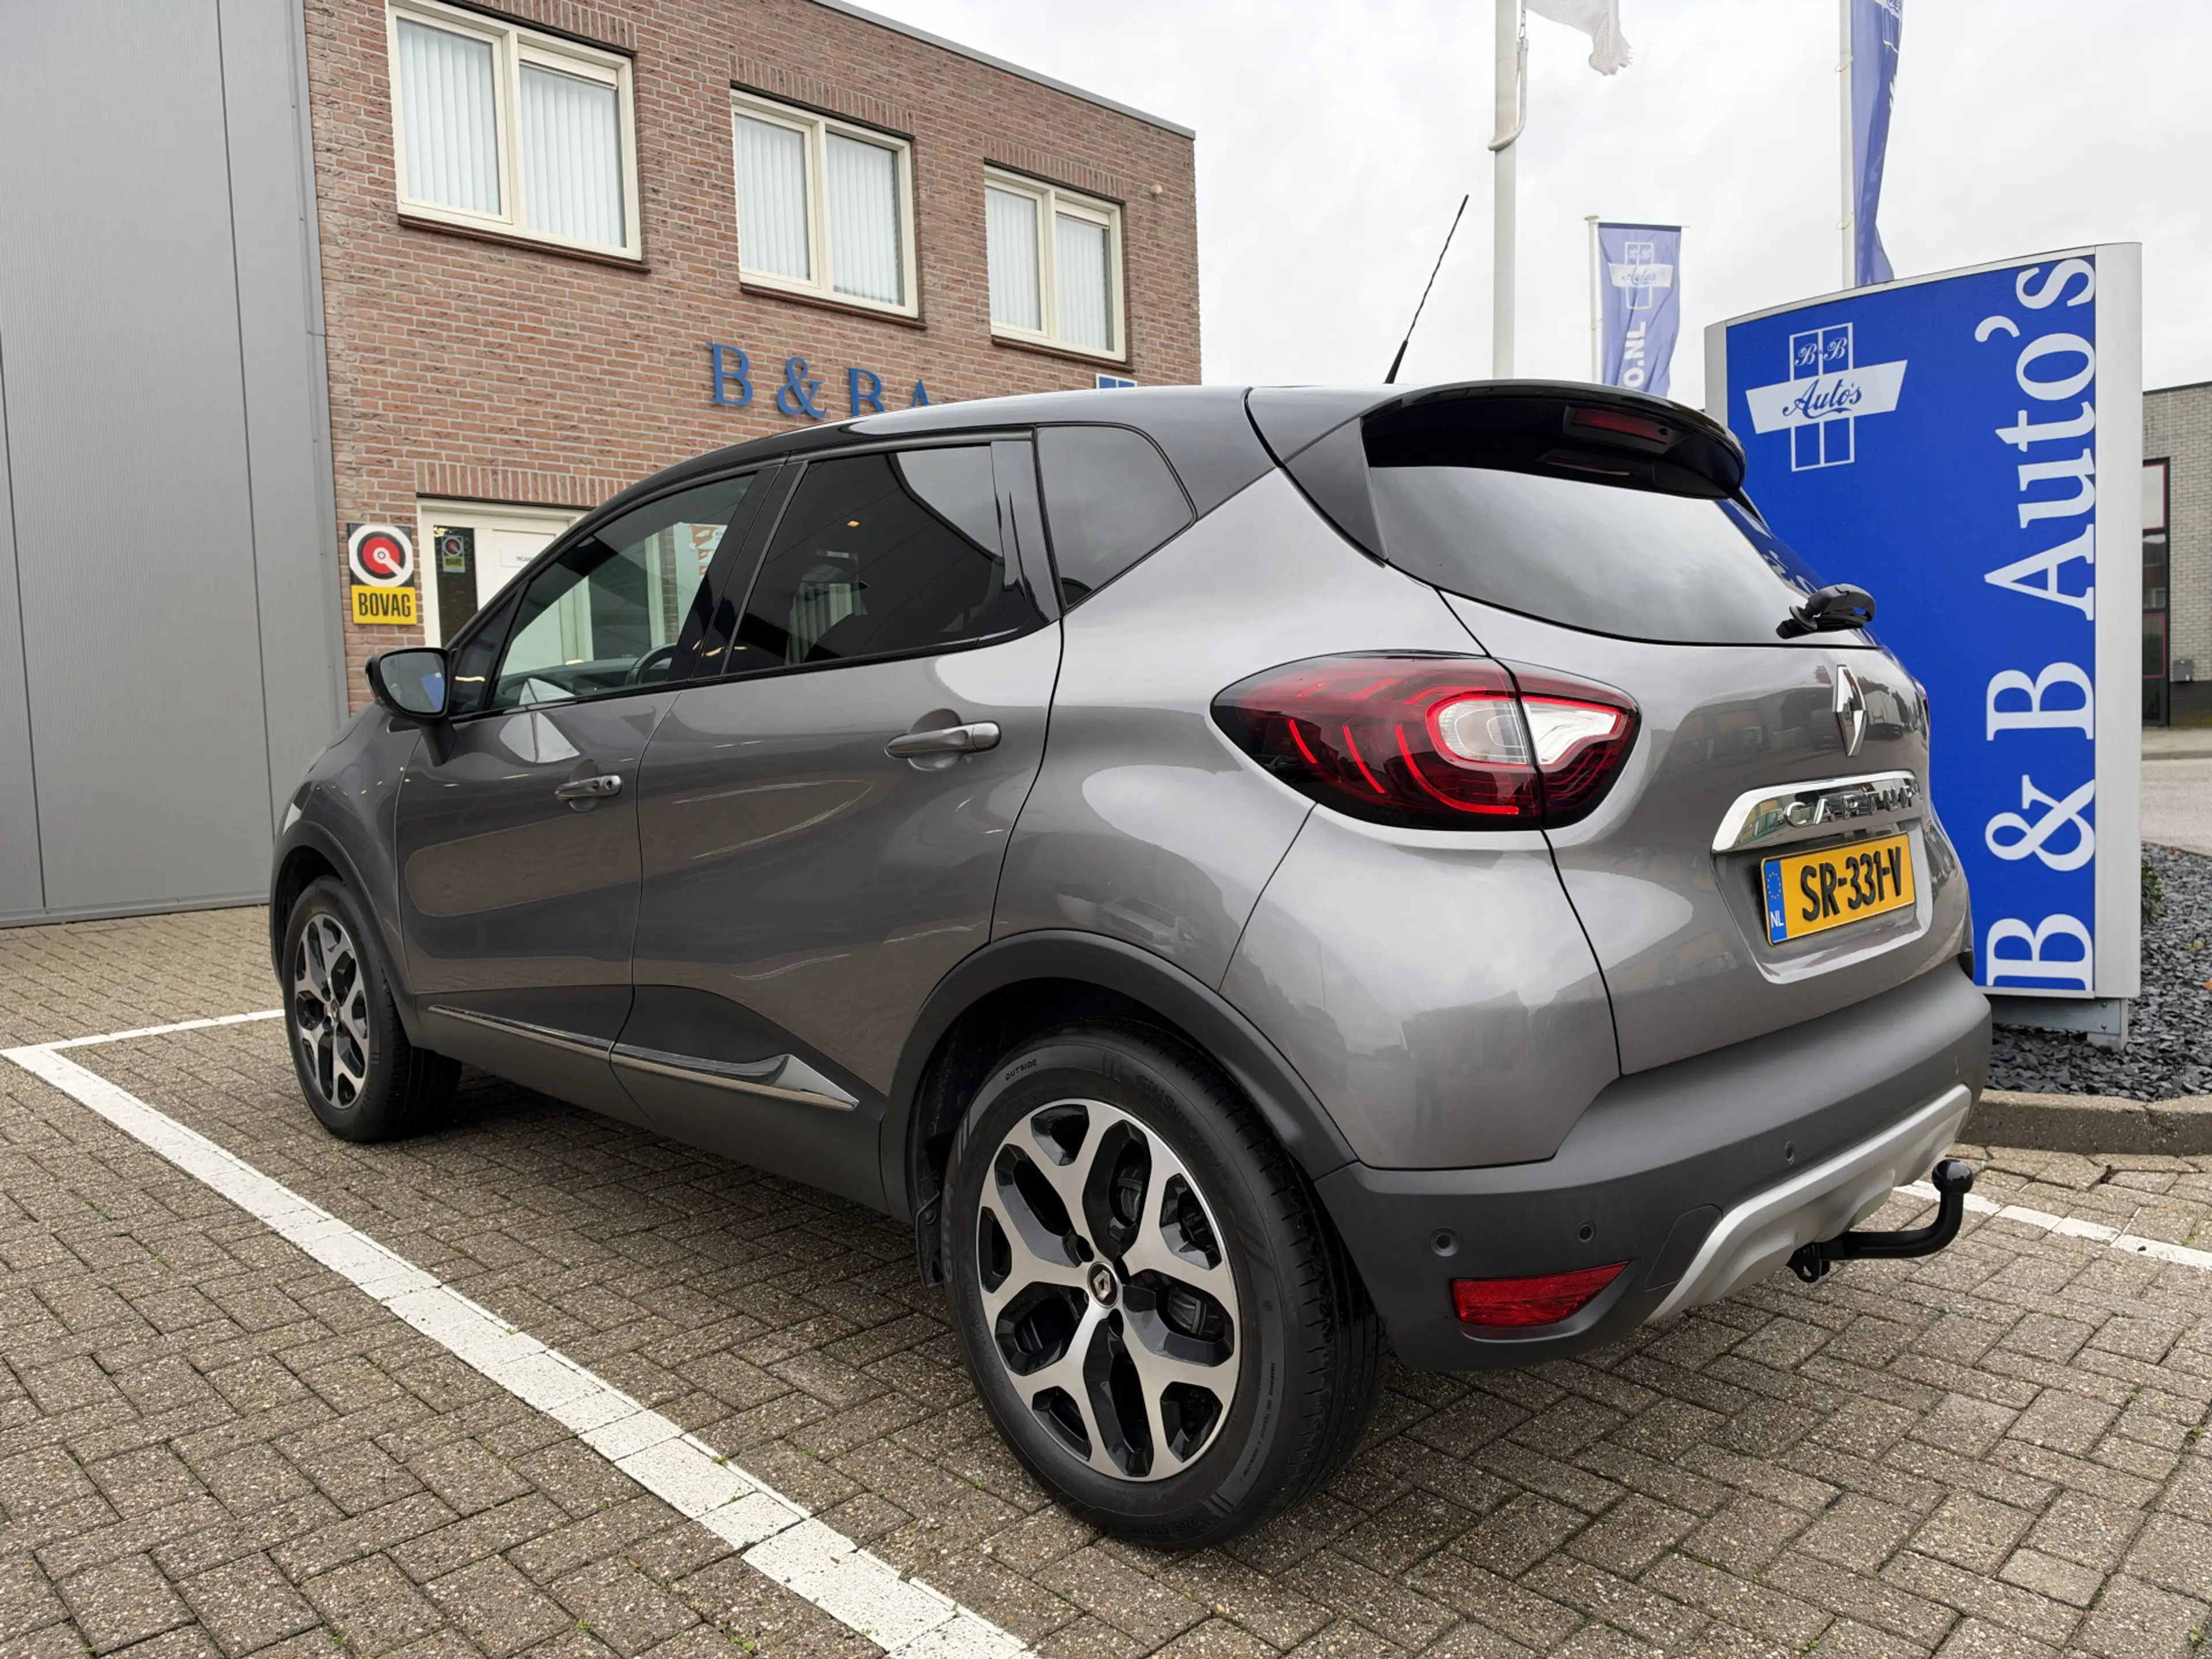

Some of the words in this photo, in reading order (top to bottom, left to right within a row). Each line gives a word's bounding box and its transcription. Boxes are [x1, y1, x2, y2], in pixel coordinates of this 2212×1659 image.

[706, 342, 754, 406] B
[777, 357, 828, 419] &
[1794, 343, 1817, 367] B
[1824, 337, 1848, 361] B
[1782, 378, 1862, 419] Auto's
[1975, 258, 2096, 621] Auto's
[358, 592, 411, 618] BOVAG
[1986, 662, 2094, 741] B
[1785, 785, 1913, 828] CAPTUR
[1984, 774, 2095, 872] &
[1800, 846, 1902, 922] SR-331-V
[1770, 910, 1784, 929] NL
[1986, 914, 2093, 991] B
[1005, 1058, 1038, 1081] OUTSIDE
